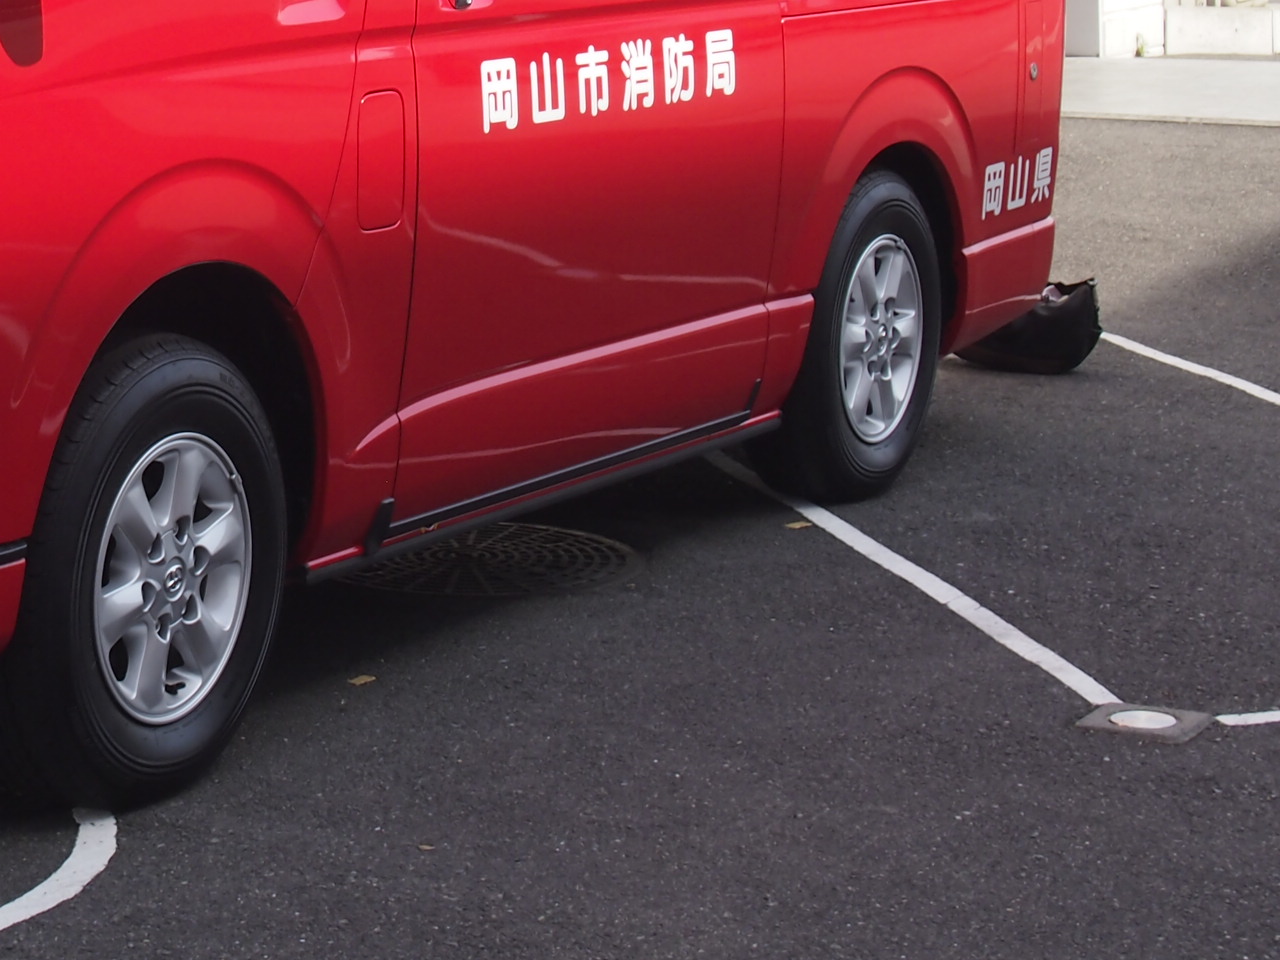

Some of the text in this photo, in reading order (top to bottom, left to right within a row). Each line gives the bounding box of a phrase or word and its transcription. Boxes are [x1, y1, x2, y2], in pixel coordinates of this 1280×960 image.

[480, 28, 736, 134] 岡山市消防局
[982, 146, 1053, 220] 岡山県
